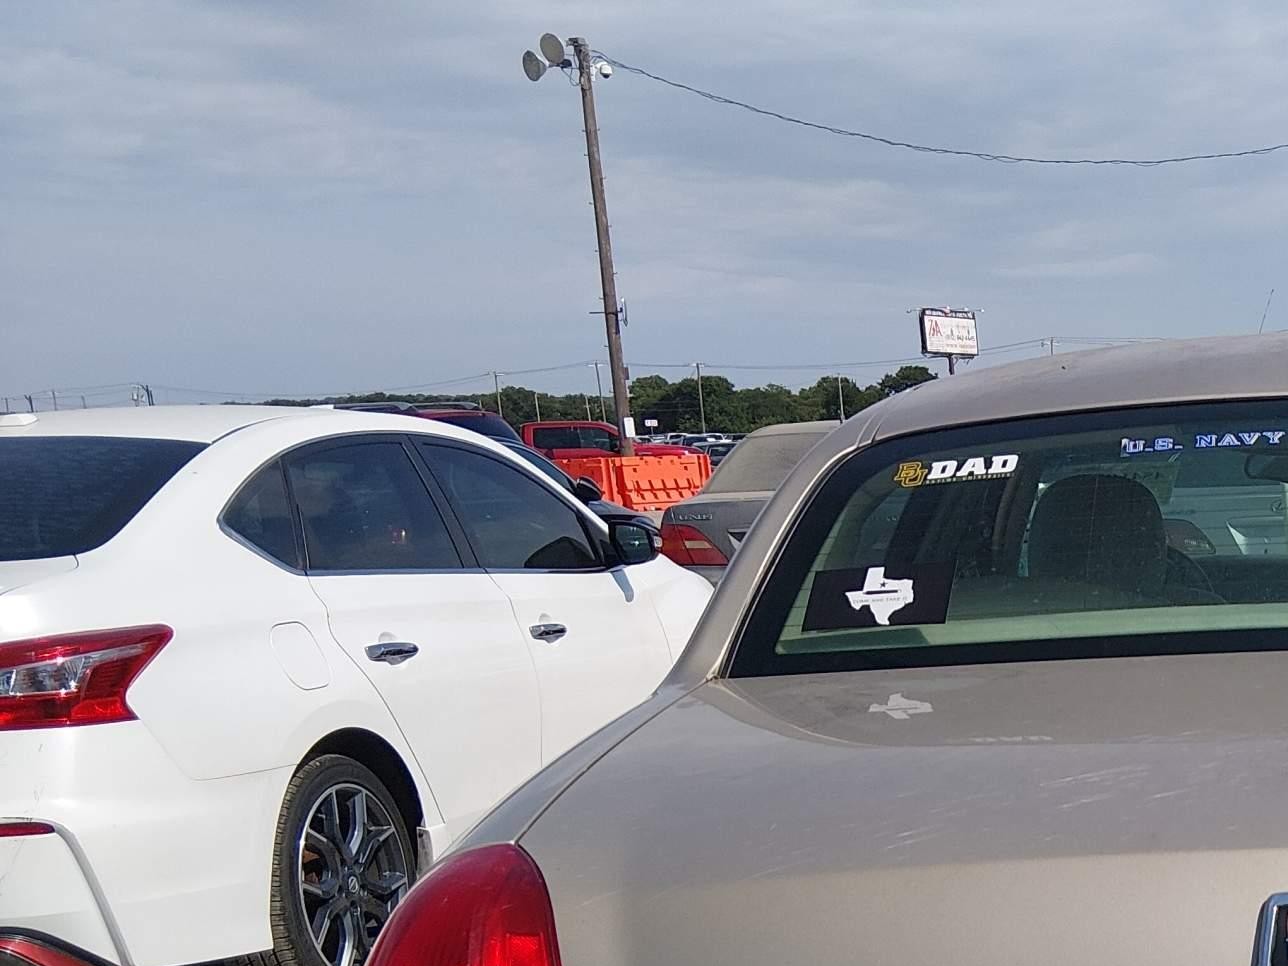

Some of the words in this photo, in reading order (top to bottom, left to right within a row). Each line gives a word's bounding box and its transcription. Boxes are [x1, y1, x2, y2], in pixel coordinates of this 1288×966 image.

[1122, 438, 1183, 454] U.S.
[1195, 431, 1285, 448] NAVY
[927, 455, 1019, 480] DAD
